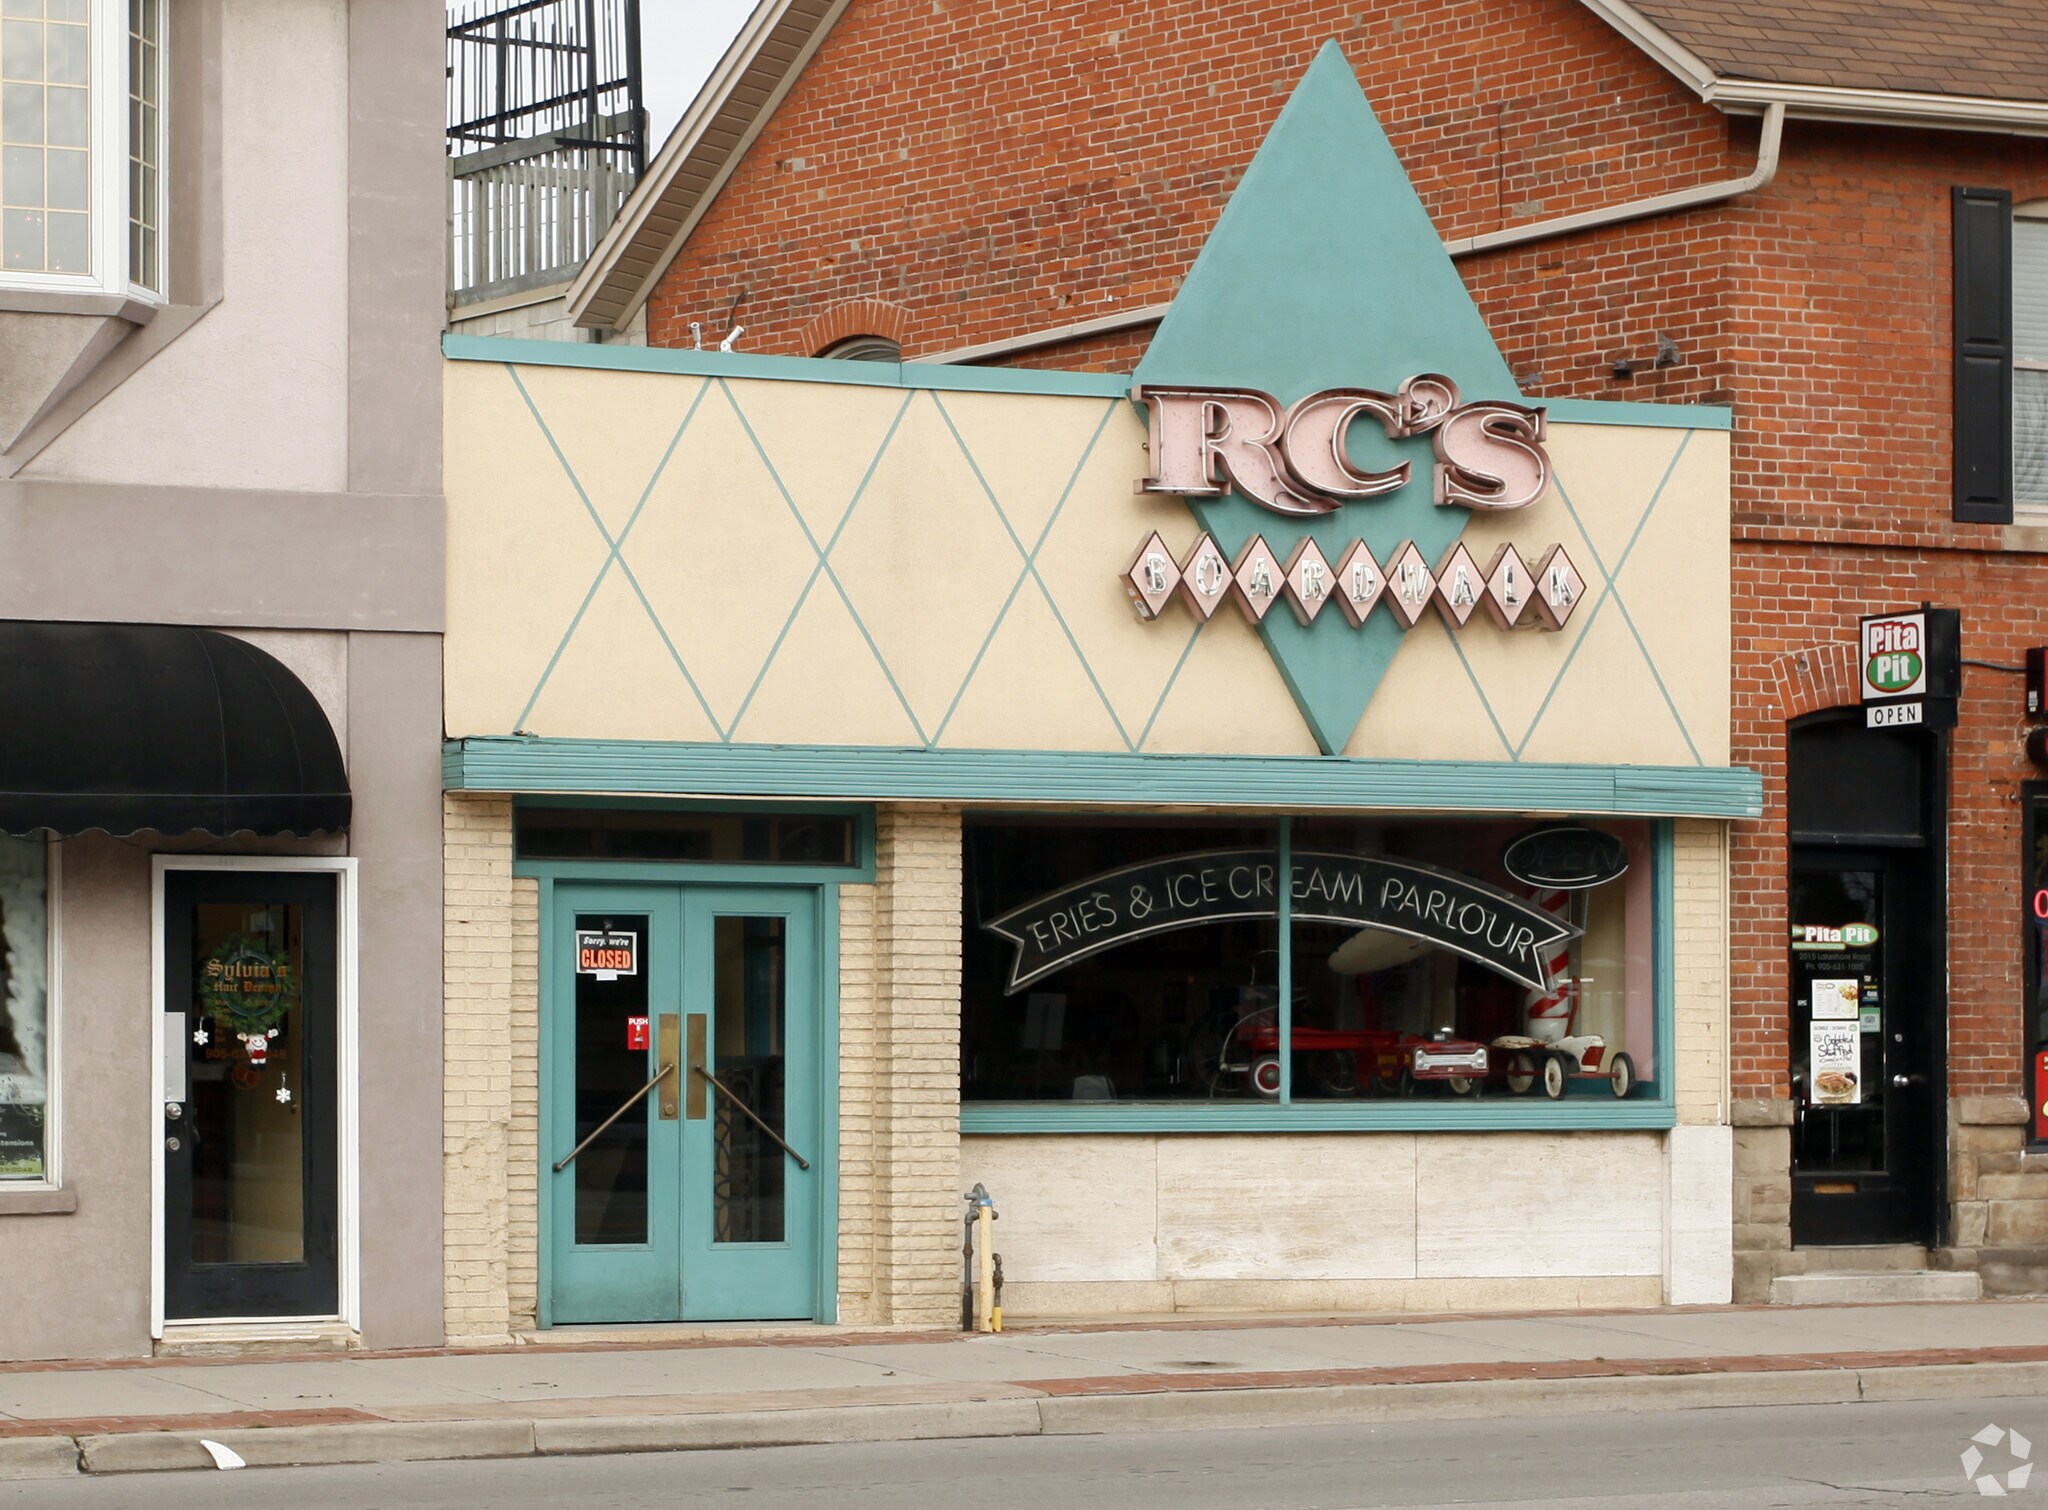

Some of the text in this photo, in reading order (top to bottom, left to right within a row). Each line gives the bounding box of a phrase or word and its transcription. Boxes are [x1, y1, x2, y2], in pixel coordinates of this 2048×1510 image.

[1133, 373, 1552, 516] RC'S
[1144, 551, 1575, 608] BOARDWALK
[1869, 622, 1918, 655] Pita
[1876, 654, 1911, 684] Pit
[1874, 705, 1917, 725] OPEN
[1026, 863, 1535, 963] FRIES & ICE CREAM PARLOUR
[608, 937, 629, 947] we're
[1804, 925, 1841, 942] Pita
[1845, 926, 1871, 942] Pit
[581, 948, 631, 969] CLOSED
[207, 958, 289, 982] Sylvia's
[213, 981, 238, 993] Hair
[628, 1017, 648, 1025] PUSH
